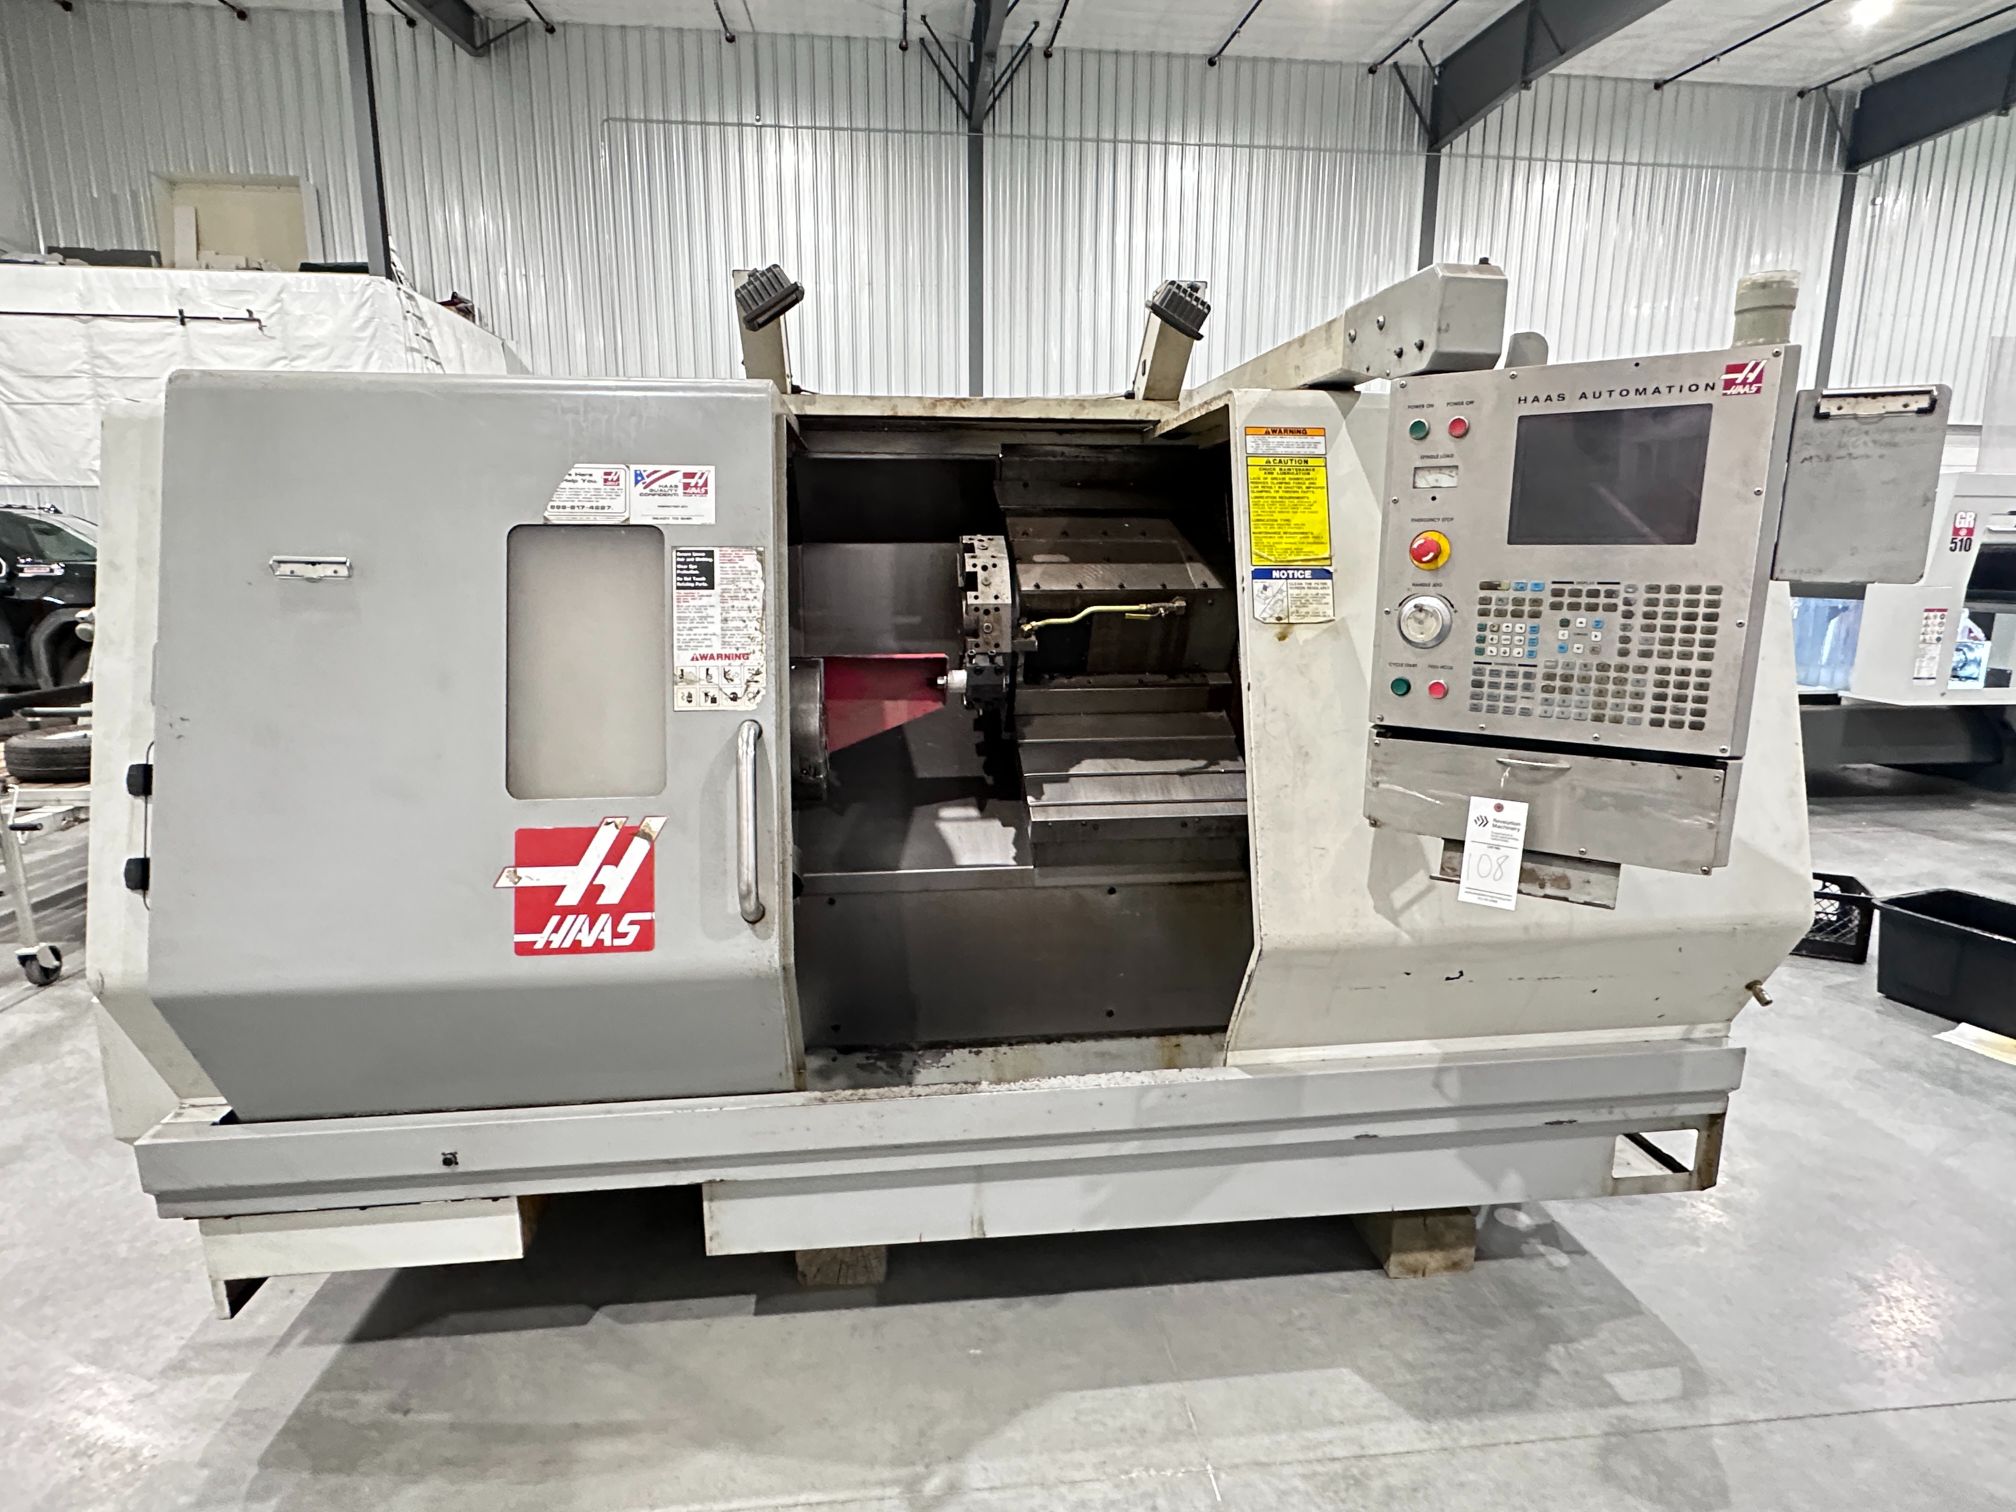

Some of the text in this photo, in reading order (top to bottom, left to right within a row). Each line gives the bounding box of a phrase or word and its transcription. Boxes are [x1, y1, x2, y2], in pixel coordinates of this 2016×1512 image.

[1518, 382, 1716, 405] HAAS AUTOMATION
[1722, 384, 1763, 397] HAAS
[1954, 511, 1977, 528] GR
[1949, 537, 1973, 552] 510
[1272, 570, 1312, 579] NOTICE
[699, 653, 752, 661] WARNING
[1467, 853, 1510, 882] 108
[513, 911, 656, 950] HAAS
